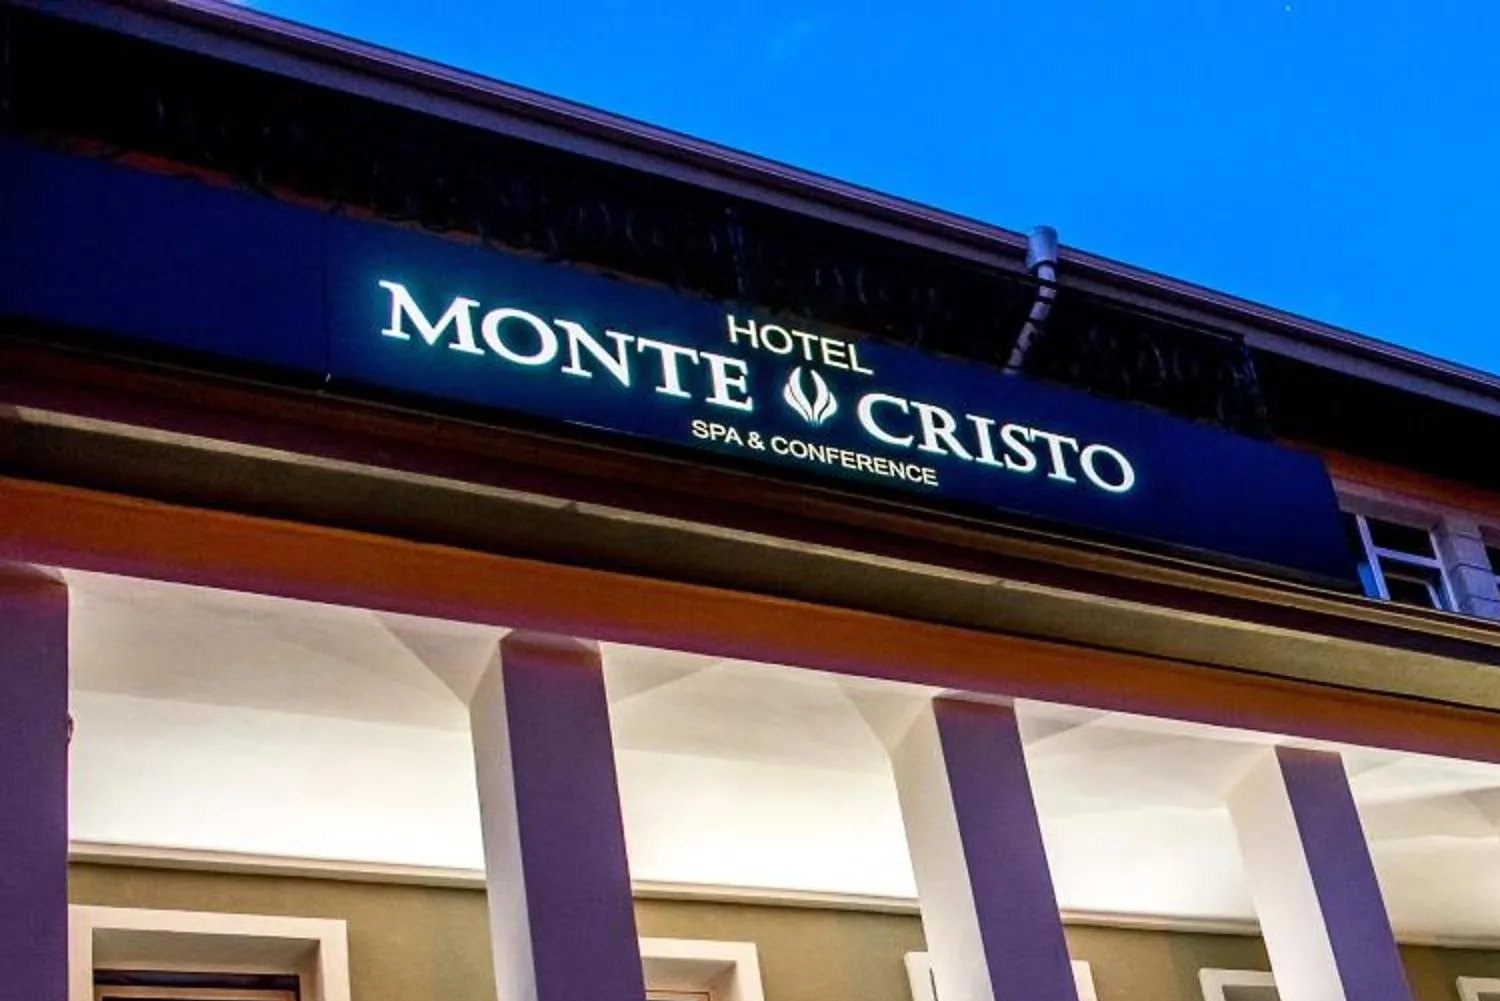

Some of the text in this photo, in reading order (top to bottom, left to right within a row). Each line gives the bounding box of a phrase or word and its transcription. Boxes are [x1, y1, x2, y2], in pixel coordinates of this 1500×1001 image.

[726, 314, 874, 375] HOTEL
[379, 280, 1135, 492] MONTE CRISTO
[691, 419, 939, 487] SPA & CONFERENCE
